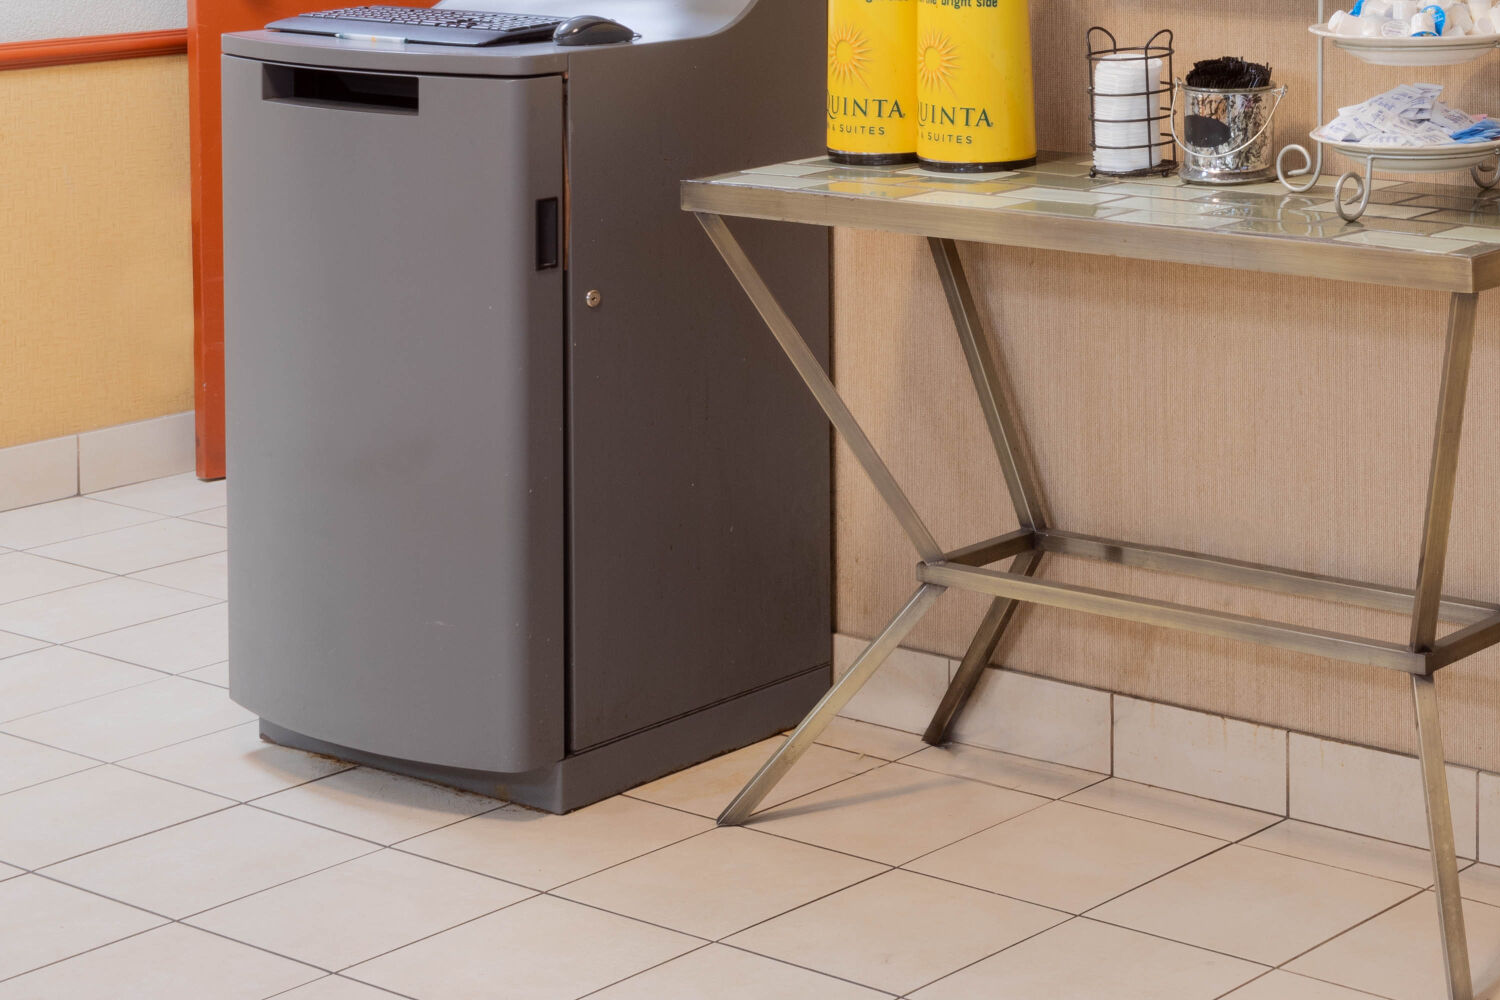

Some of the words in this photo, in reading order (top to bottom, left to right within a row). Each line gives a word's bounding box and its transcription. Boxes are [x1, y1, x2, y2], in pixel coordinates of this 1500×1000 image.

[918, 101, 992, 128] UINTA
[840, 124, 885, 136] SUITES
[928, 131, 972, 145] SUITES
